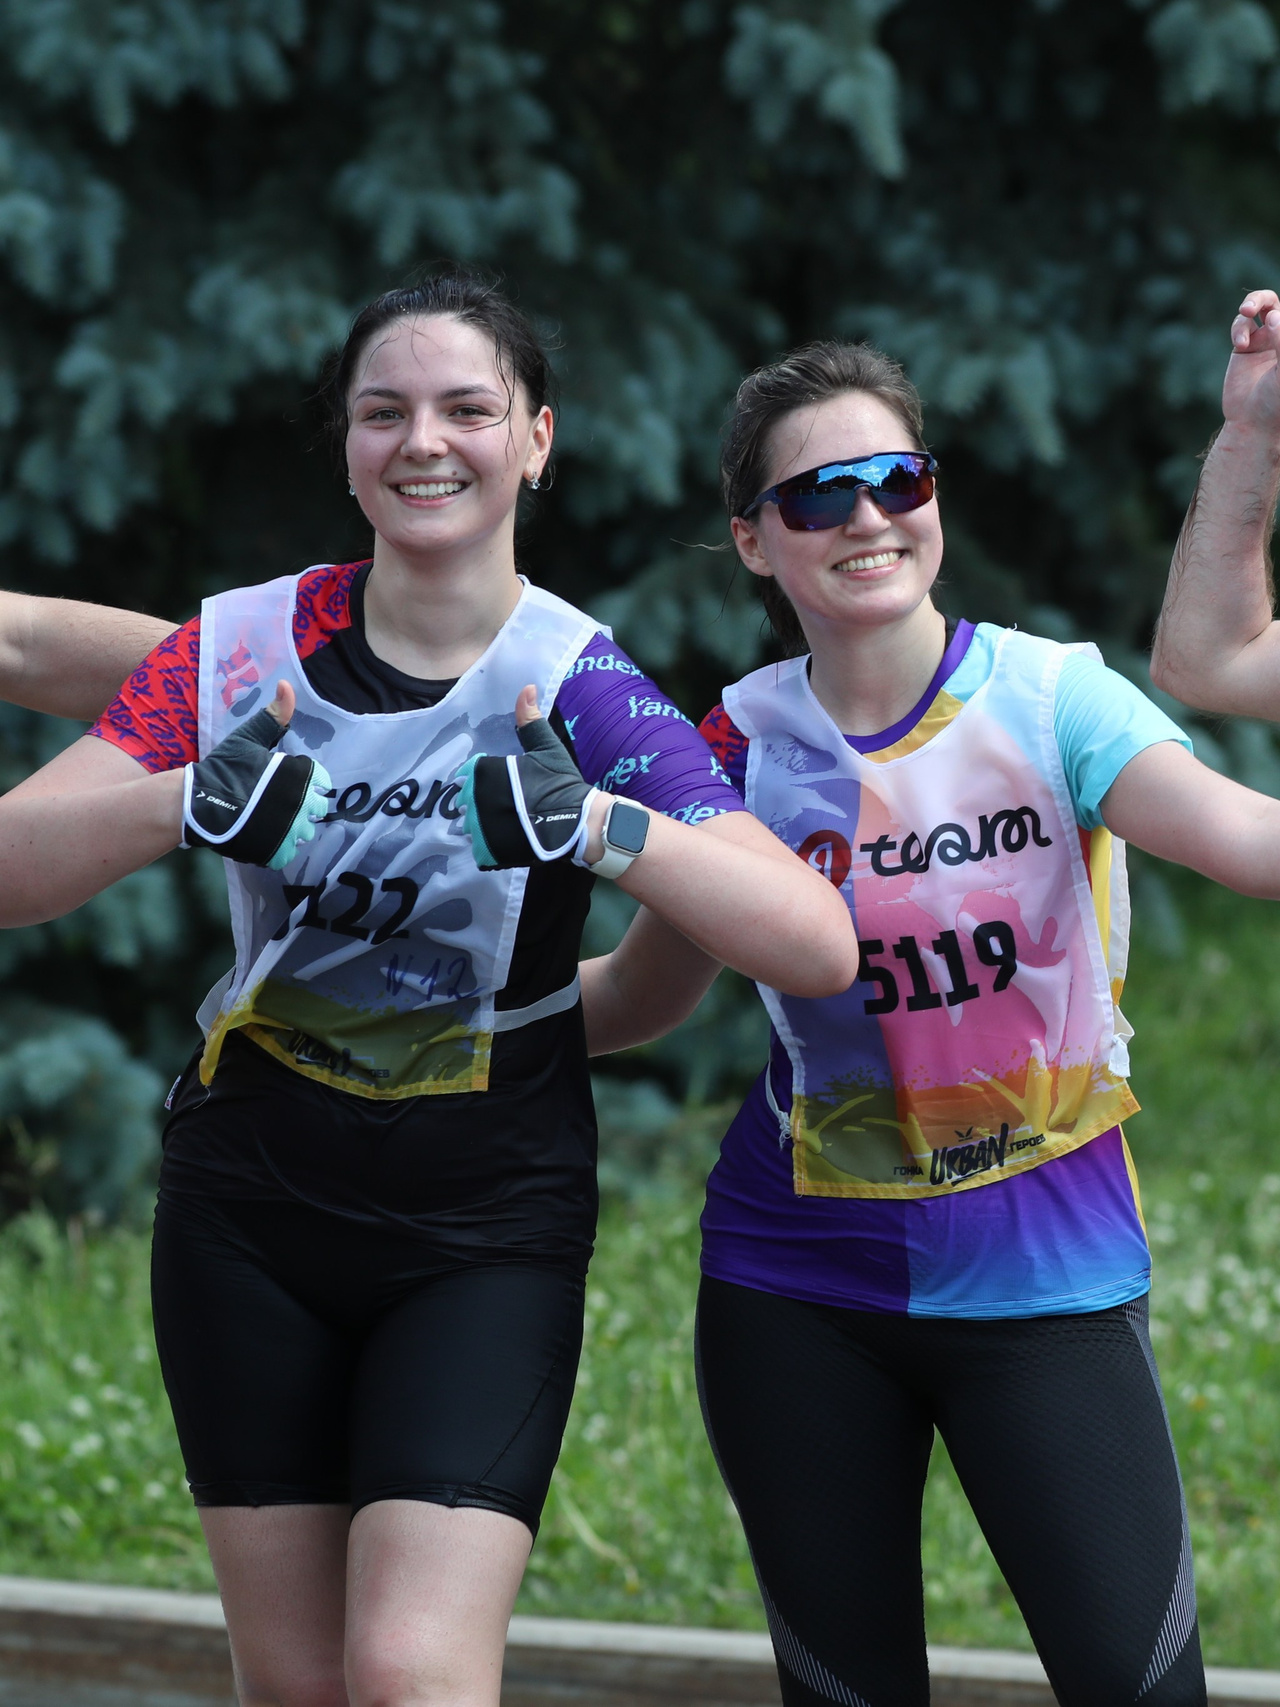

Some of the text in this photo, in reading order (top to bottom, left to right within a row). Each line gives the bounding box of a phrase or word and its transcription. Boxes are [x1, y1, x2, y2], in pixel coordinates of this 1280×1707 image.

[206, 795, 239, 811] DEMIX
[546, 813, 579, 823] DEMIX
[860, 806, 1052, 877] team
[857, 920, 1017, 1016] 5119
[893, 1122, 1047, 1186] ГОНКА URBAN ГЕРОЕВ
